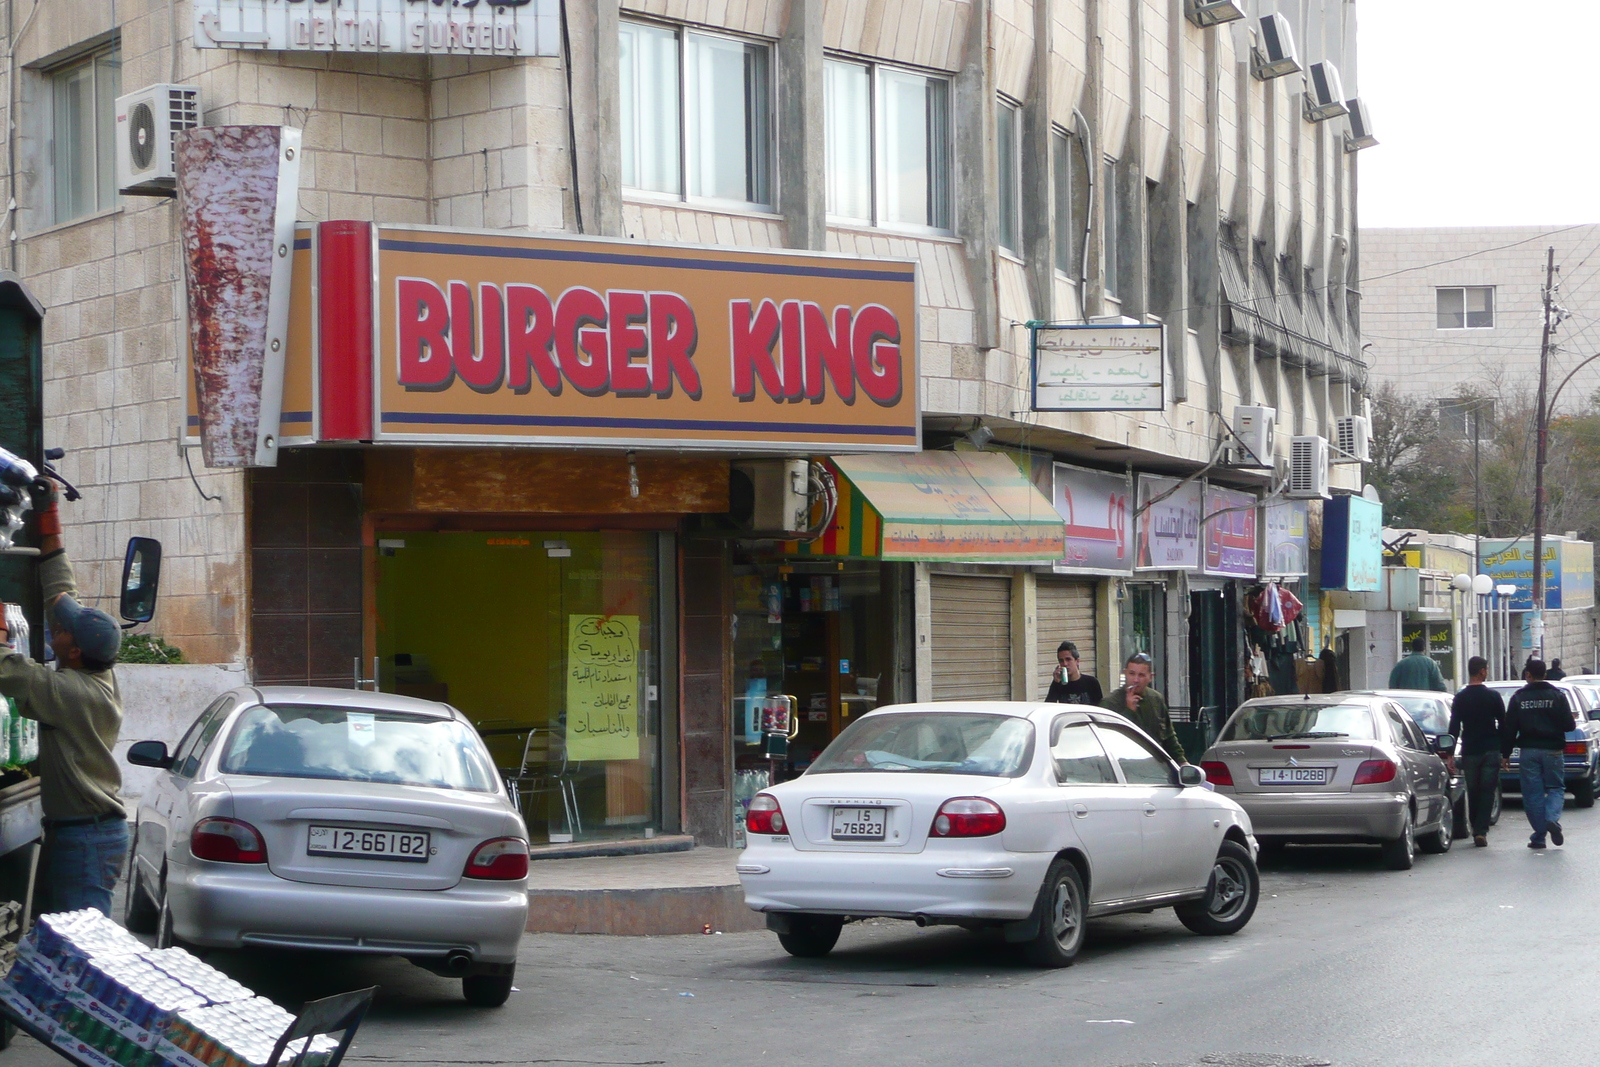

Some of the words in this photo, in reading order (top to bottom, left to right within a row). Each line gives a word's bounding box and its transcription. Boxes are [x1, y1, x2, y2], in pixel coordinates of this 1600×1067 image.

[295, 18, 391, 47] DENTAL
[412, 20, 521, 50] SURGEON
[396, 276, 702, 400] BURGER
[730, 298, 902, 407] KING
[1482, 548, 1521, 567] العربي
[1523, 547, 1557, 562] البت
[602, 669, 632, 683] استعداد
[1520, 700, 1554, 709] SECURITY
[574, 712, 630, 738] والمناسبات
[857, 810, 871, 822] 15
[843, 823, 882, 835] 76823
[96, 1004, 119, 1024] PEPSI
[85, 1047, 108, 1066] PEPSI
